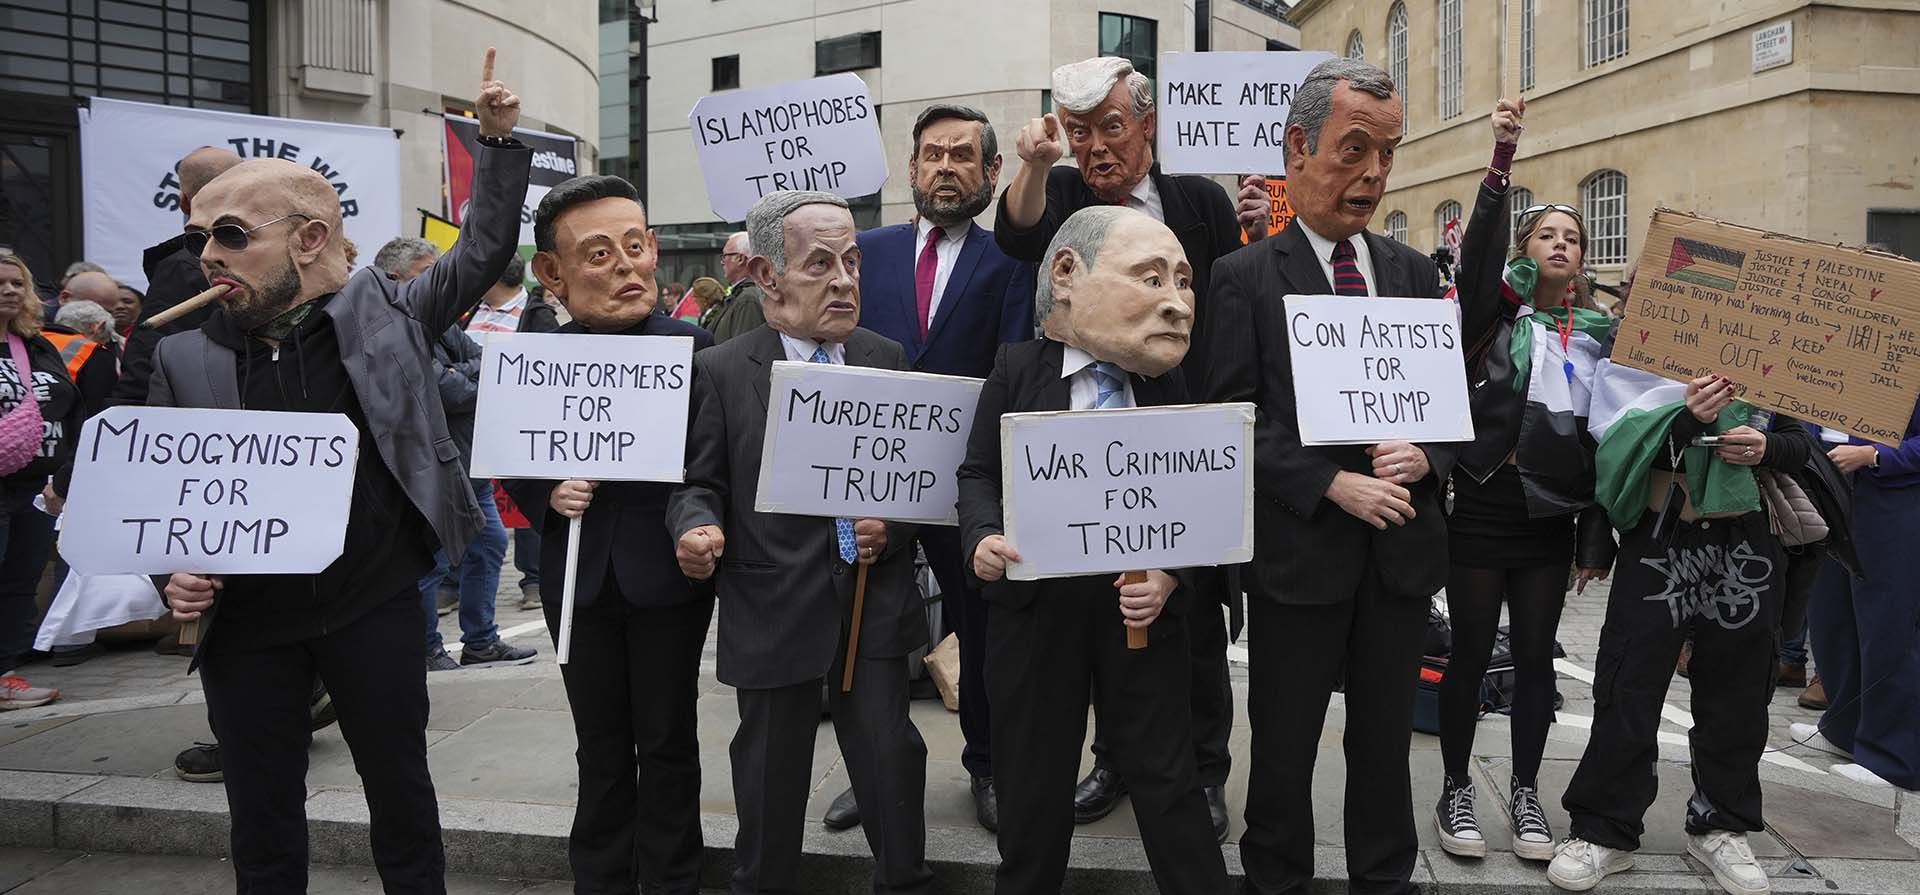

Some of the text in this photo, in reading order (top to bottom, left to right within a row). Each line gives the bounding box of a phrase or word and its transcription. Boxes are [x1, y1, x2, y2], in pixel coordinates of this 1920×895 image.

[1755, 26, 1785, 42] LANGHAM
[1755, 38, 1777, 52] STREET
[1168, 81, 1222, 106] MAKE
[697, 95, 868, 146] ISLAMOPHOBES
[1177, 121, 1240, 147] HATE
[531, 151, 575, 175] estine
[765, 136, 813, 164] FOR
[227, 137, 300, 163] THE
[310, 156, 359, 218] WAR
[745, 161, 846, 198] TRUMP
[1748, 262, 1791, 277] JUSTICE
[1815, 275, 1857, 296] NEPAL
[1753, 250, 1886, 283] JUSTICE 4 PALESTINE
[1738, 281, 1901, 327] JUSTICE 4 THE CHILDREN
[1745, 272, 1787, 288] JUSTICE
[1811, 288, 1850, 304] CONGO
[1292, 312, 1455, 350] CON ARTISTS
[1640, 299, 1690, 326] BUILD
[1700, 313, 1709, 330] A
[1719, 318, 1761, 341] WALL
[1791, 336, 1825, 354] KEEP
[1690, 286, 1723, 306] Trump
[1726, 296, 1745, 310] was
[1795, 311, 1821, 327] class
[1898, 330, 1915, 343] HE
[1673, 329, 1763, 372] HIM OUT
[1887, 351, 1905, 363] BE
[1888, 342, 1920, 357] WOUL
[497, 352, 685, 390] MISINFORMERS
[1363, 357, 1406, 381] FOR
[1825, 369, 1845, 378] not
[1870, 372, 1903, 389] JAIL
[1880, 362, 1901, 374] IN
[562, 395, 612, 422] FOR
[787, 388, 963, 434] MURDERERS
[1339, 391, 1431, 424] TRUMP
[1770, 391, 1849, 426] Isabelle
[91, 417, 347, 468] MISOGYNISTS
[519, 430, 636, 462] TRUMP
[852, 436, 907, 464] FOR
[1025, 440, 1237, 481] WAR CRIMINALS
[178, 478, 249, 506] FOR
[811, 465, 936, 503] TRUMP
[1104, 486, 1158, 510] FOR
[122, 517, 290, 556] TRUMP
[1067, 521, 1187, 555] TRUMP
